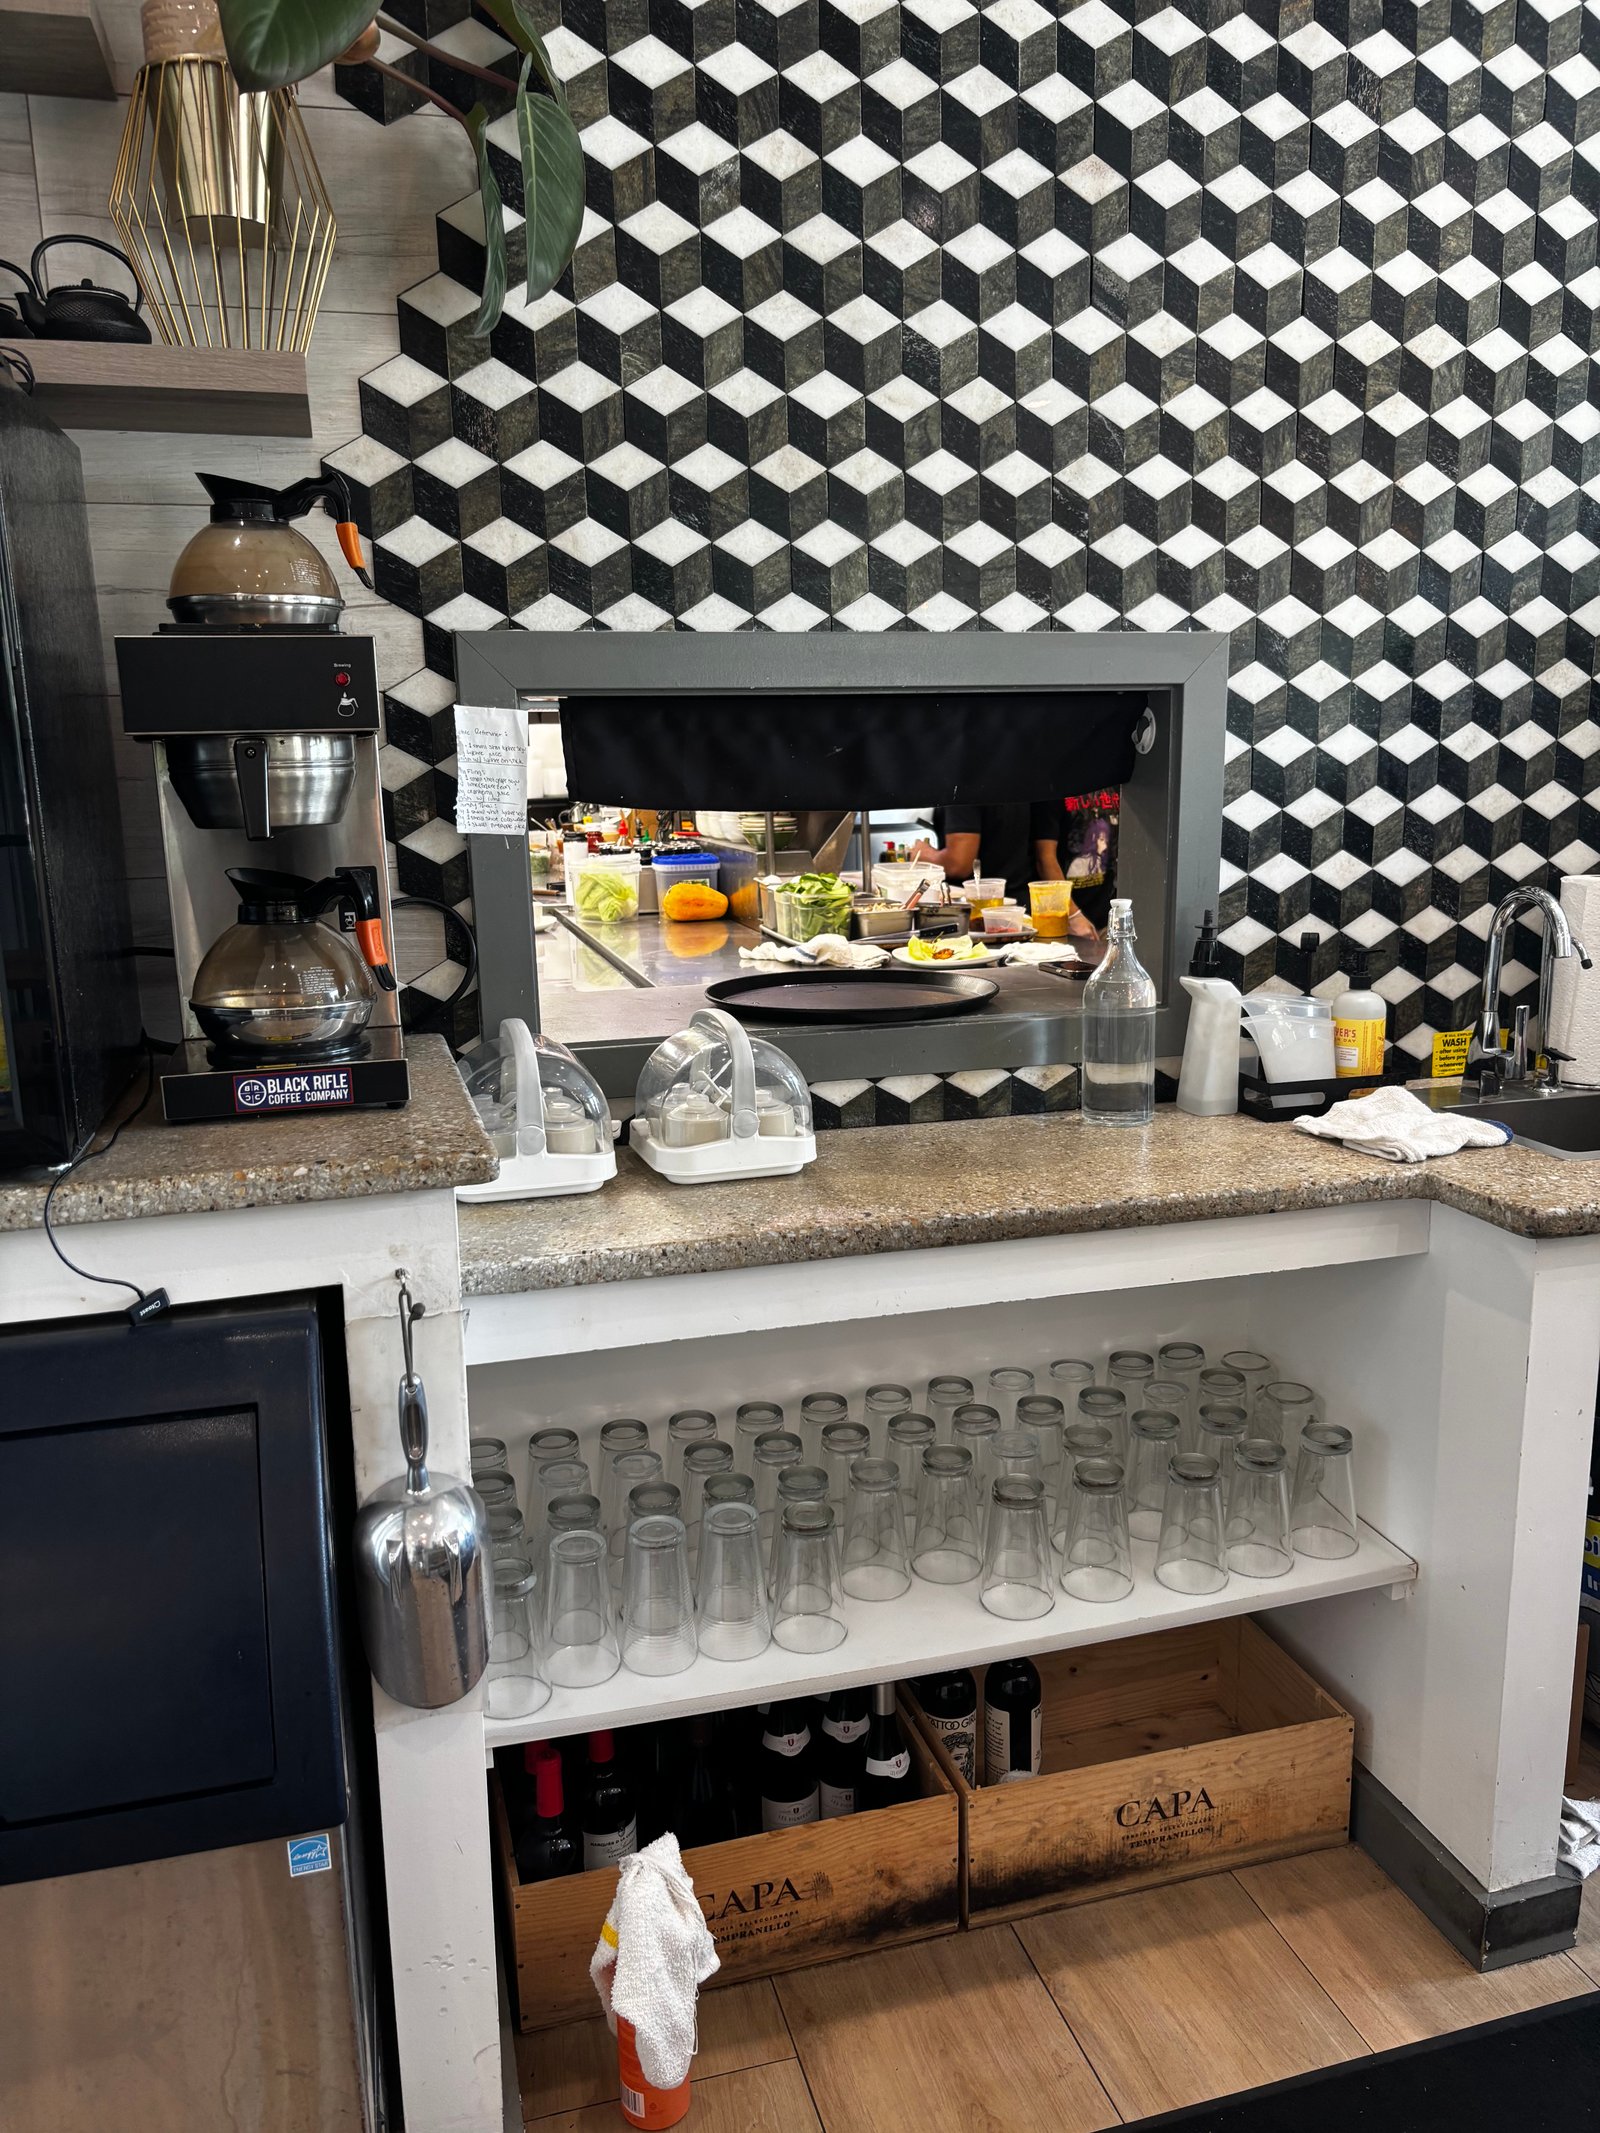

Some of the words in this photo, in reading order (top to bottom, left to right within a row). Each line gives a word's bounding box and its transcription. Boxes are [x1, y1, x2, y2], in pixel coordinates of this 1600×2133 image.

[1334, 1027, 1357, 1038] YER'S
[1442, 1037, 1467, 1047] WASH
[267, 1076, 310, 1094] BLACK
[312, 1073, 348, 1090] RIFLE
[268, 1092, 302, 1105] COFFEE
[305, 1088, 349, 1102] COMPANY
[1116, 1787, 1217, 1828] CAPA
[1129, 1827, 1204, 1849] TEMPRANILLO
[293, 1864, 314, 1873] ENERGY
[314, 1860, 329, 1869] STAR
[697, 1877, 803, 1920] CAPA
[714, 1920, 791, 1945] EMPRANILLO
